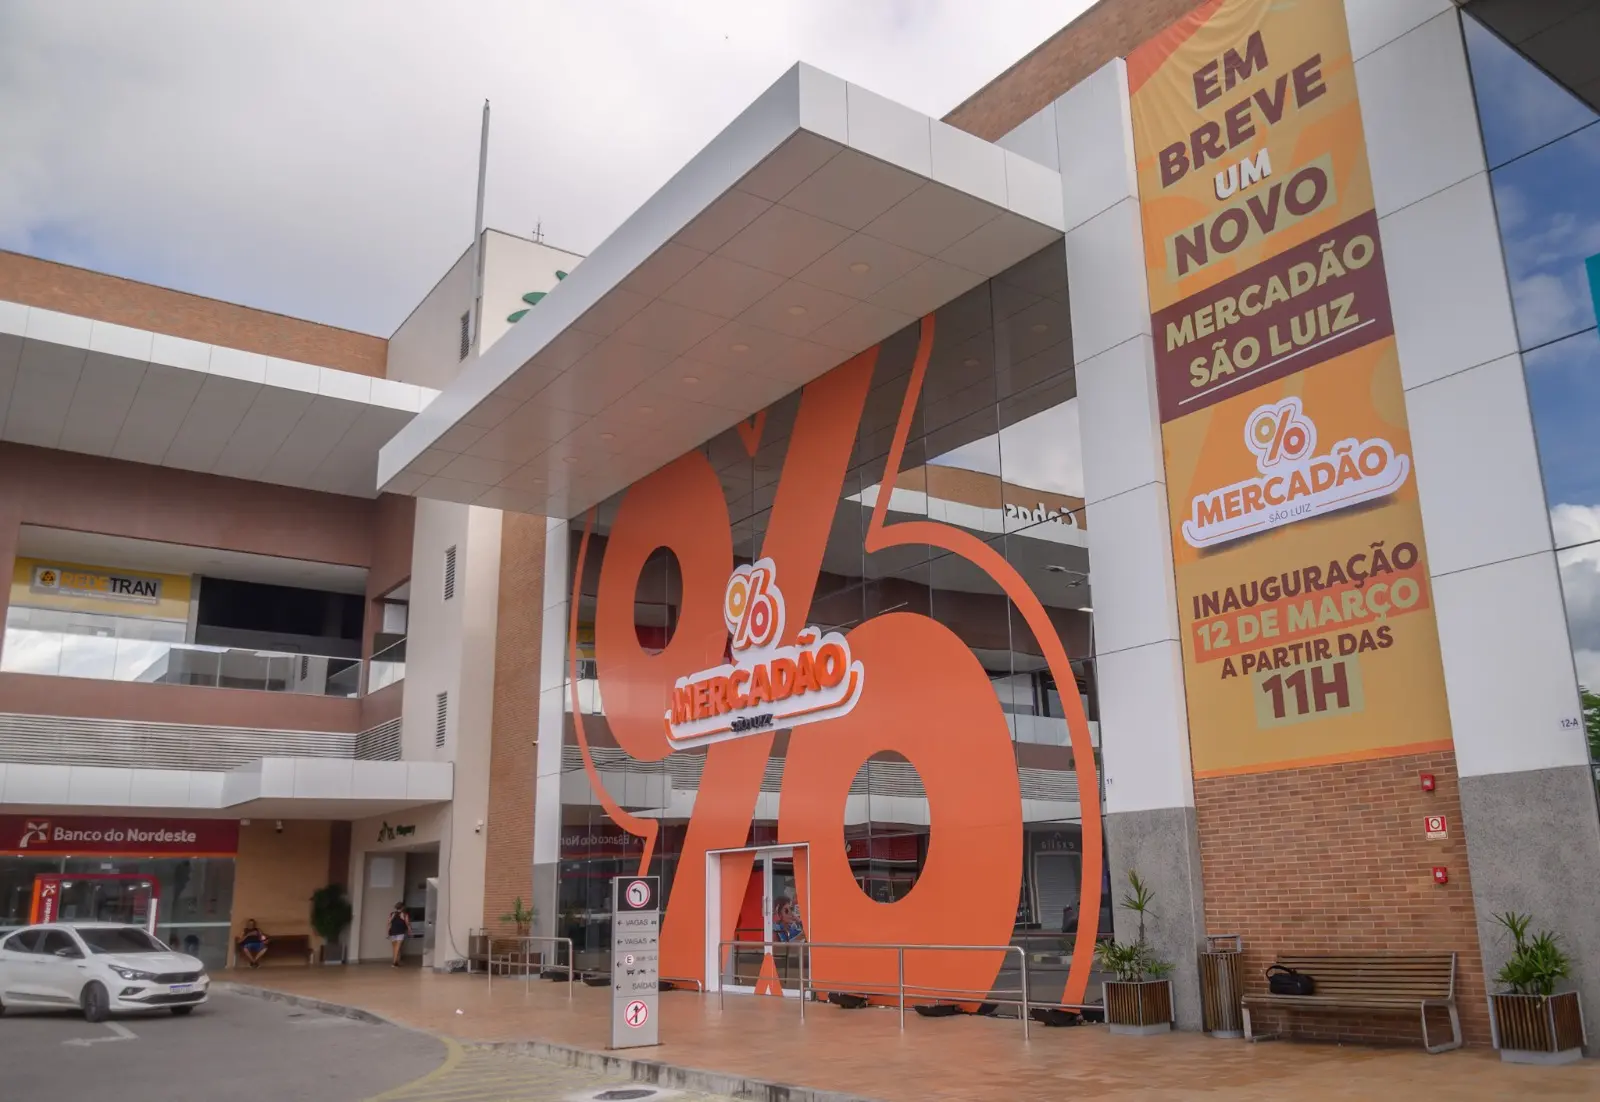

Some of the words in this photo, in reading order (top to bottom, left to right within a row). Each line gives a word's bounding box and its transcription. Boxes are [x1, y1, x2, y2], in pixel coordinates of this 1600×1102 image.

[1192, 30, 1269, 109] EM
[1159, 53, 1327, 188] BREVE
[1213, 148, 1272, 200] UM
[1173, 165, 1328, 277] NOVO
[1165, 234, 1375, 352] MERCADÃO
[1189, 338, 1260, 388] SÃO
[1269, 293, 1360, 357] LUIZ
[1197, 444, 1388, 529] MERCADÃO
[1268, 510, 1288, 523] SÃO
[1291, 503, 1311, 517] LUIZ
[1192, 540, 1418, 620] INAUGURAÇÃO
[1197, 620, 1231, 652] 12
[1236, 608, 1280, 644] DE
[1287, 577, 1420, 633] MARÇO
[671, 633, 847, 726] MERCADÃO
[1220, 657, 1238, 680] A
[1241, 638, 1333, 676] PARTIR
[1337, 625, 1394, 657] DAS
[1261, 661, 1350, 719] 11H
[1560, 717, 1579, 728] 12-A
[54, 827, 102, 841] Banco
[104, 828, 124, 842] do
[127, 829, 196, 842] Nordeste
